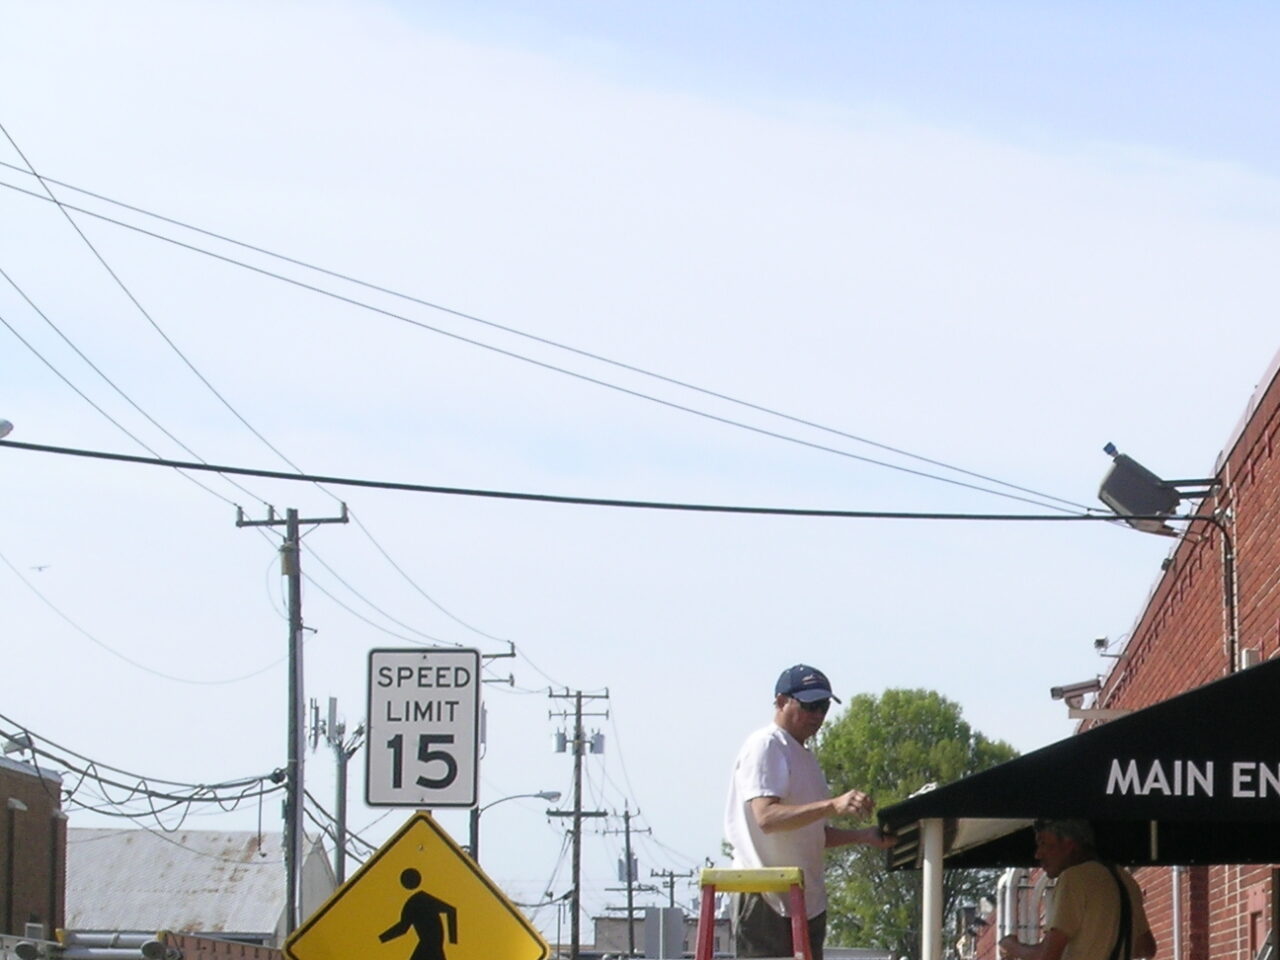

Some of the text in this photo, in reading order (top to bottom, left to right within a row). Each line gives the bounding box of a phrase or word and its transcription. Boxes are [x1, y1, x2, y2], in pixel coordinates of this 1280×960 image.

[377, 666, 471, 689] SPEED
[386, 700, 459, 722] LIMIT
[386, 733, 458, 791] 15
[1105, 758, 1215, 798] MAIN
